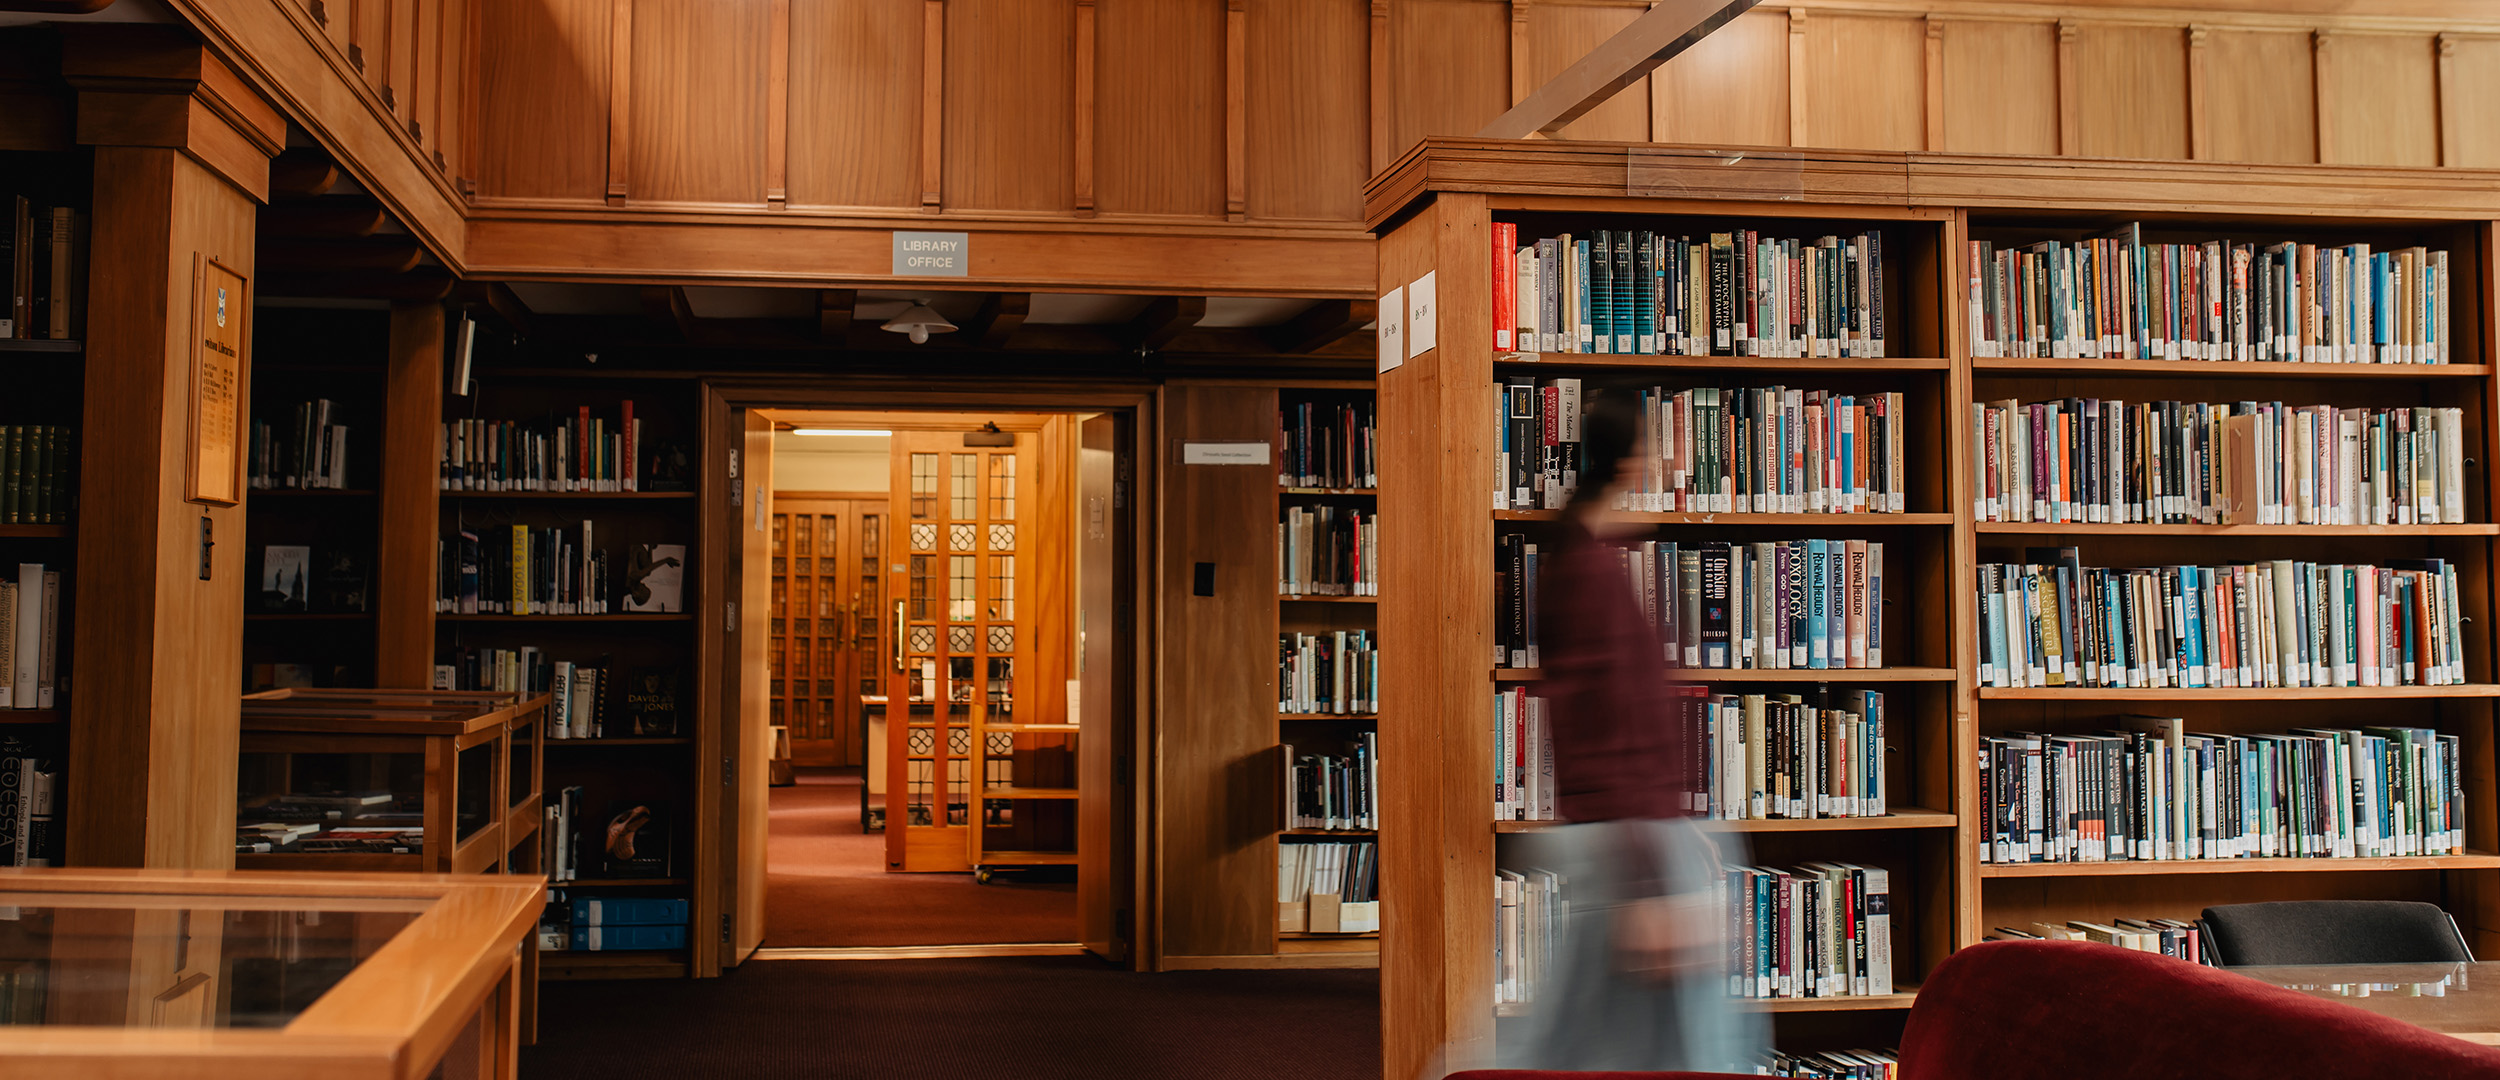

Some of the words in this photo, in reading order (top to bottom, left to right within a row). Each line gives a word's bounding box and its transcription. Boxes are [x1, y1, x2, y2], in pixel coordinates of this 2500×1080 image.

[903, 240, 957, 252] LIBRARY
[907, 256, 953, 268] OFFICE
[1987, 412, 1996, 468] CHRISTOLOGY
[1564, 443, 1573, 471] Theolog
[514, 529, 526, 553] ART
[514, 554, 526, 564] &
[1763, 547, 1773, 580] SYSTEMATIC
[514, 564, 526, 603] TODAY
[1705, 557, 1714, 600] THEOLOGY
[1713, 557, 1728, 600] Christian
[1789, 545, 1802, 620] DOXOLOGY
[1764, 580, 1773, 616] THEOLOGY
[1872, 590, 1880, 609] Bride
[2046, 588, 2056, 619] JESUS
[2185, 584, 2197, 620] JESUS
[1817, 621, 1823, 630] 1
[1836, 622, 1843, 631] 2
[1855, 620, 1862, 629] 3
[2041, 593, 2053, 653] SCRIPTURE
[2050, 618, 2060, 651] according
[554, 675, 566, 696] ART
[627, 694, 659, 703] DAVID
[643, 703, 674, 713] JONES
[554, 697, 566, 726] NOW
[1527, 736, 1537, 778] theory
[1543, 737, 1554, 778] reality
[1998, 768, 2006, 805] Cruciformity
[2452, 769, 2460, 787] Sacred
[17, 795, 28, 825] Ethiopia
[1982, 789, 1990, 841] CRUCIFIXION
[2033, 789, 2042, 820] CROSS
[17, 823, 25, 840] and
[16, 839, 25, 852] the
[1780, 877, 1789, 891] Setting
[1780, 890, 1789, 898] the
[1745, 888, 1753, 925] SEXISM
[1781, 897, 1789, 909] Table
[1820, 907, 1828, 921] Sex,
[1759, 902, 1767, 939] Discipleship
[1820, 921, 1828, 937] Race,
[1856, 920, 1865, 931] Lift
[1759, 938, 1767, 949] of
[1855, 929, 1865, 946] Every
[1745, 934, 1753, 977] GOD-TAL
[1759, 948, 1767, 971] Equals
[1857, 944, 1865, 960] Voice
